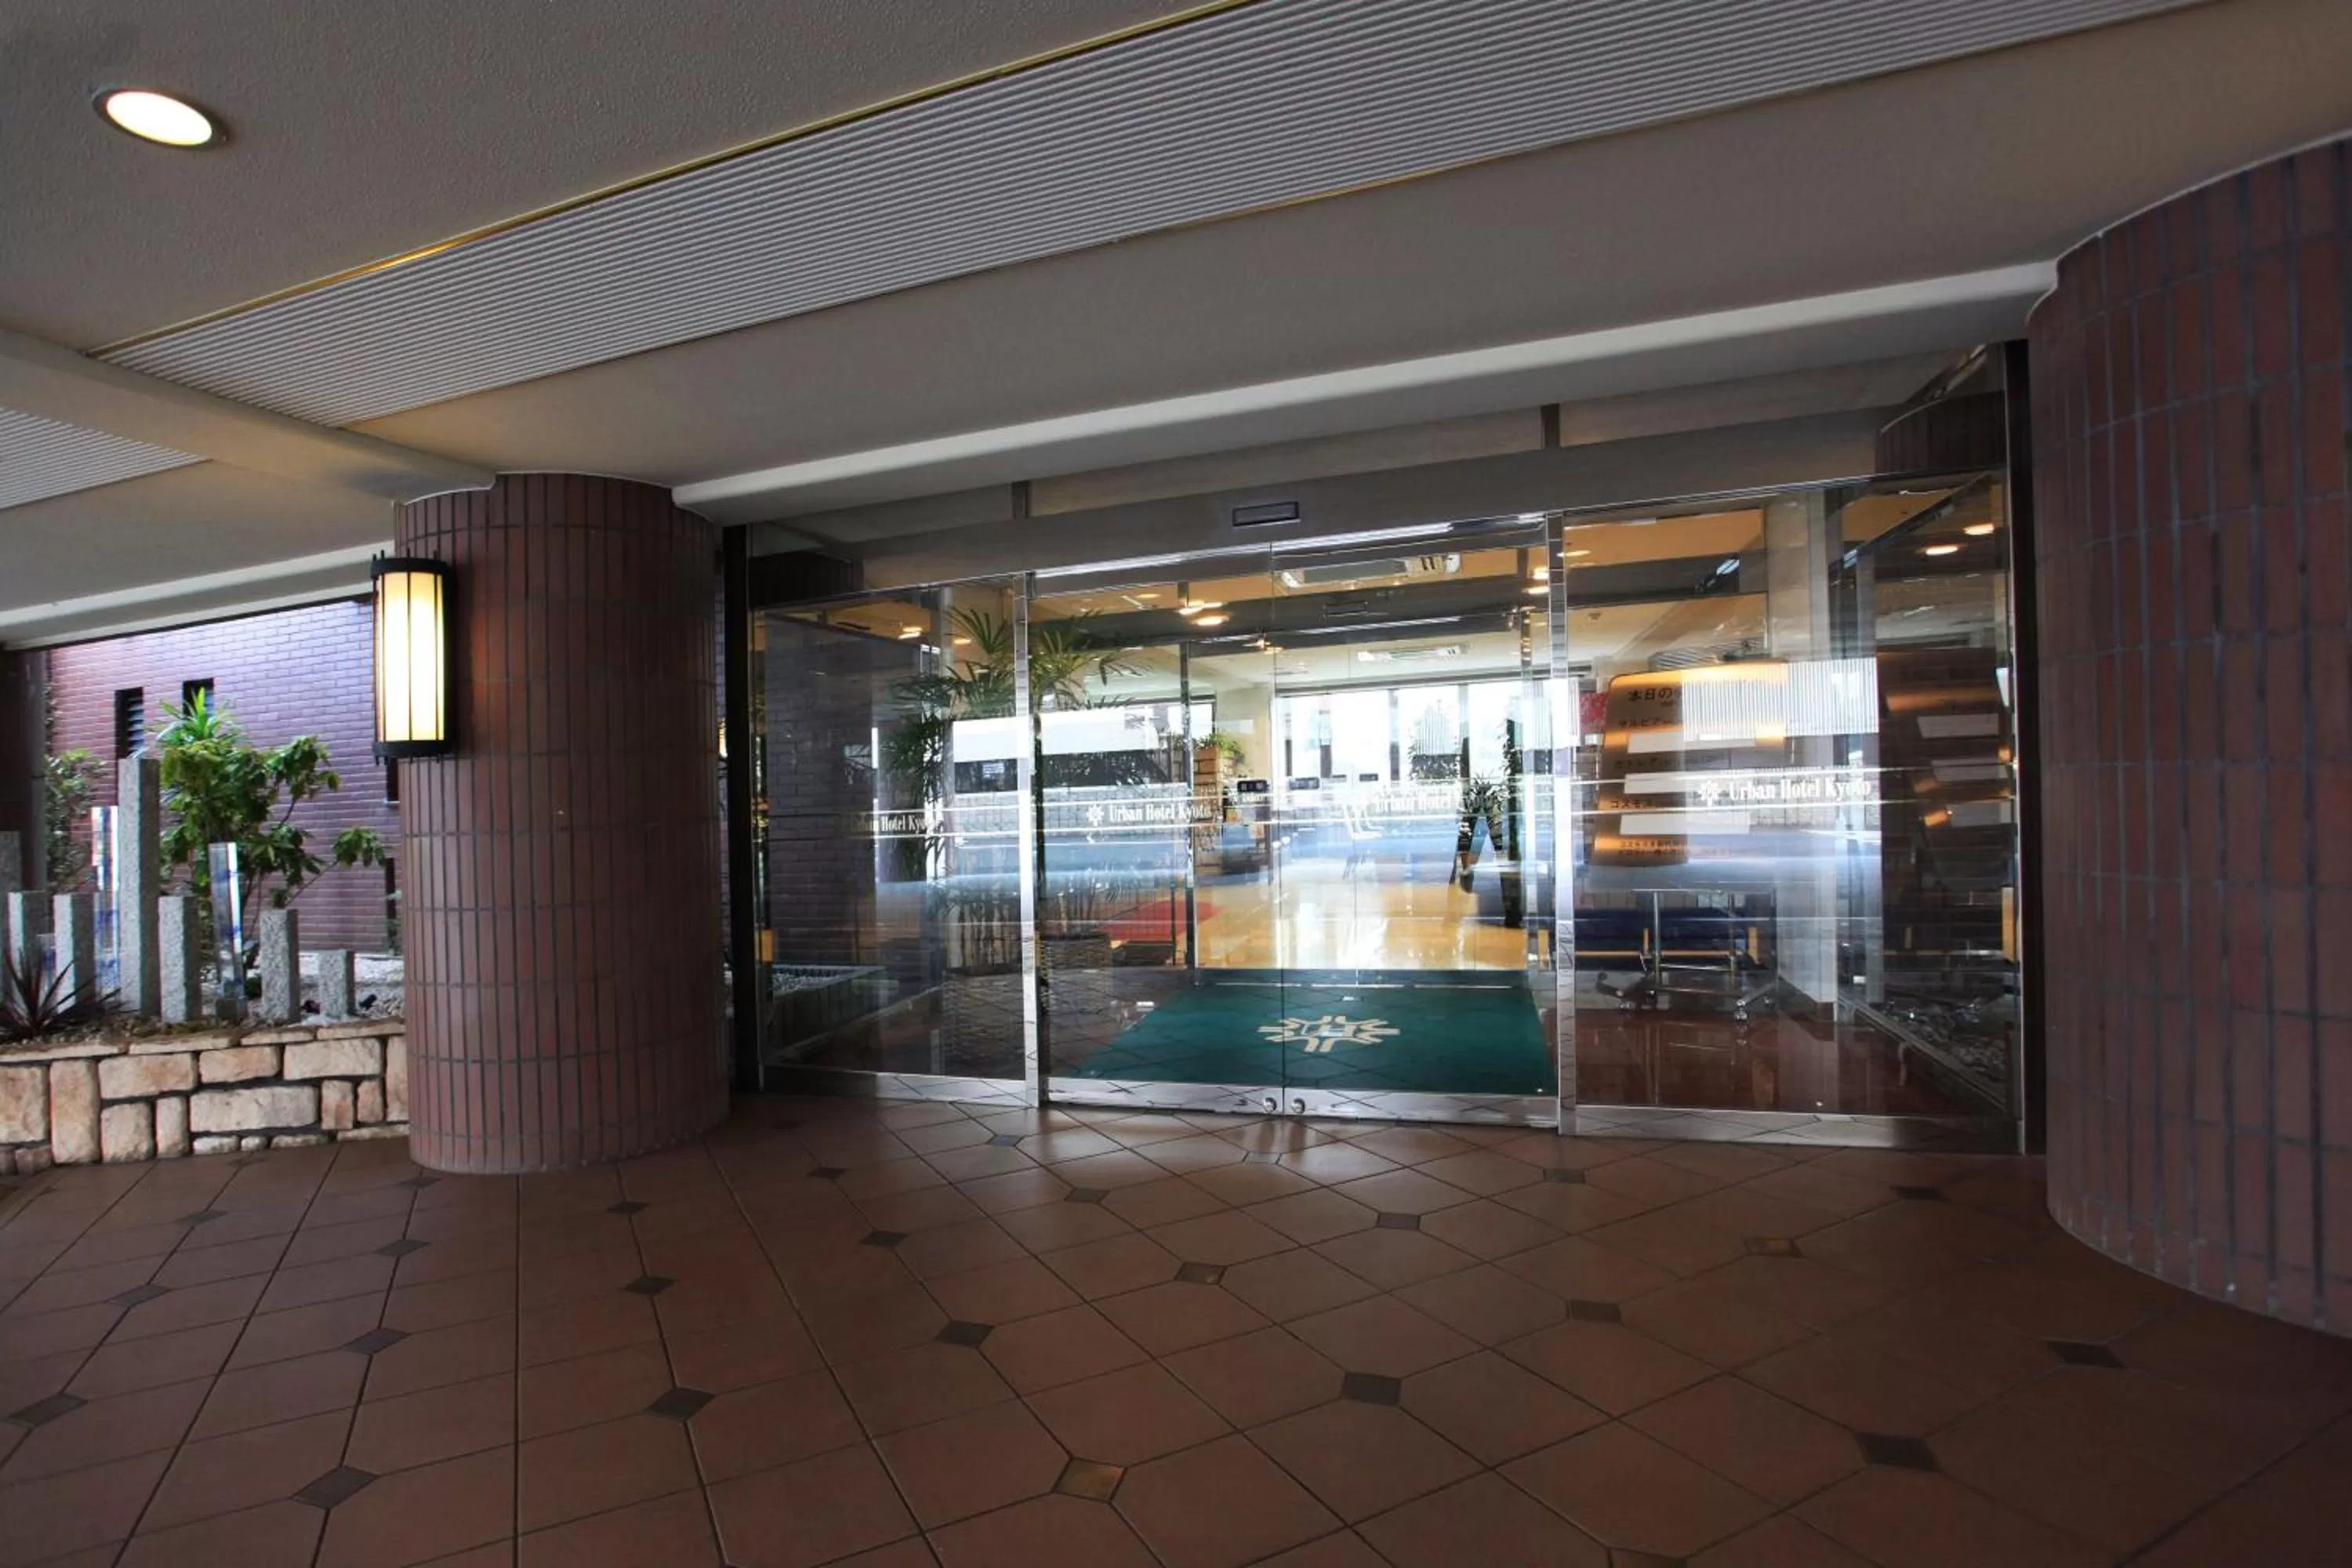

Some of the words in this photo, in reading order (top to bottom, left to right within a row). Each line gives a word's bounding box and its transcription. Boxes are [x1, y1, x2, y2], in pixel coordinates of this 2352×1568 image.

[1730, 780, 1775, 800] Urban
[1780, 778, 1820, 799] Hotel
[1825, 776, 1871, 800] Kyoto
[1109, 803, 1143, 822] Urban
[1145, 803, 1175, 821] Hotel
[1178, 802, 1212, 822] Kyoto
[880, 815, 906, 831] Hotel
